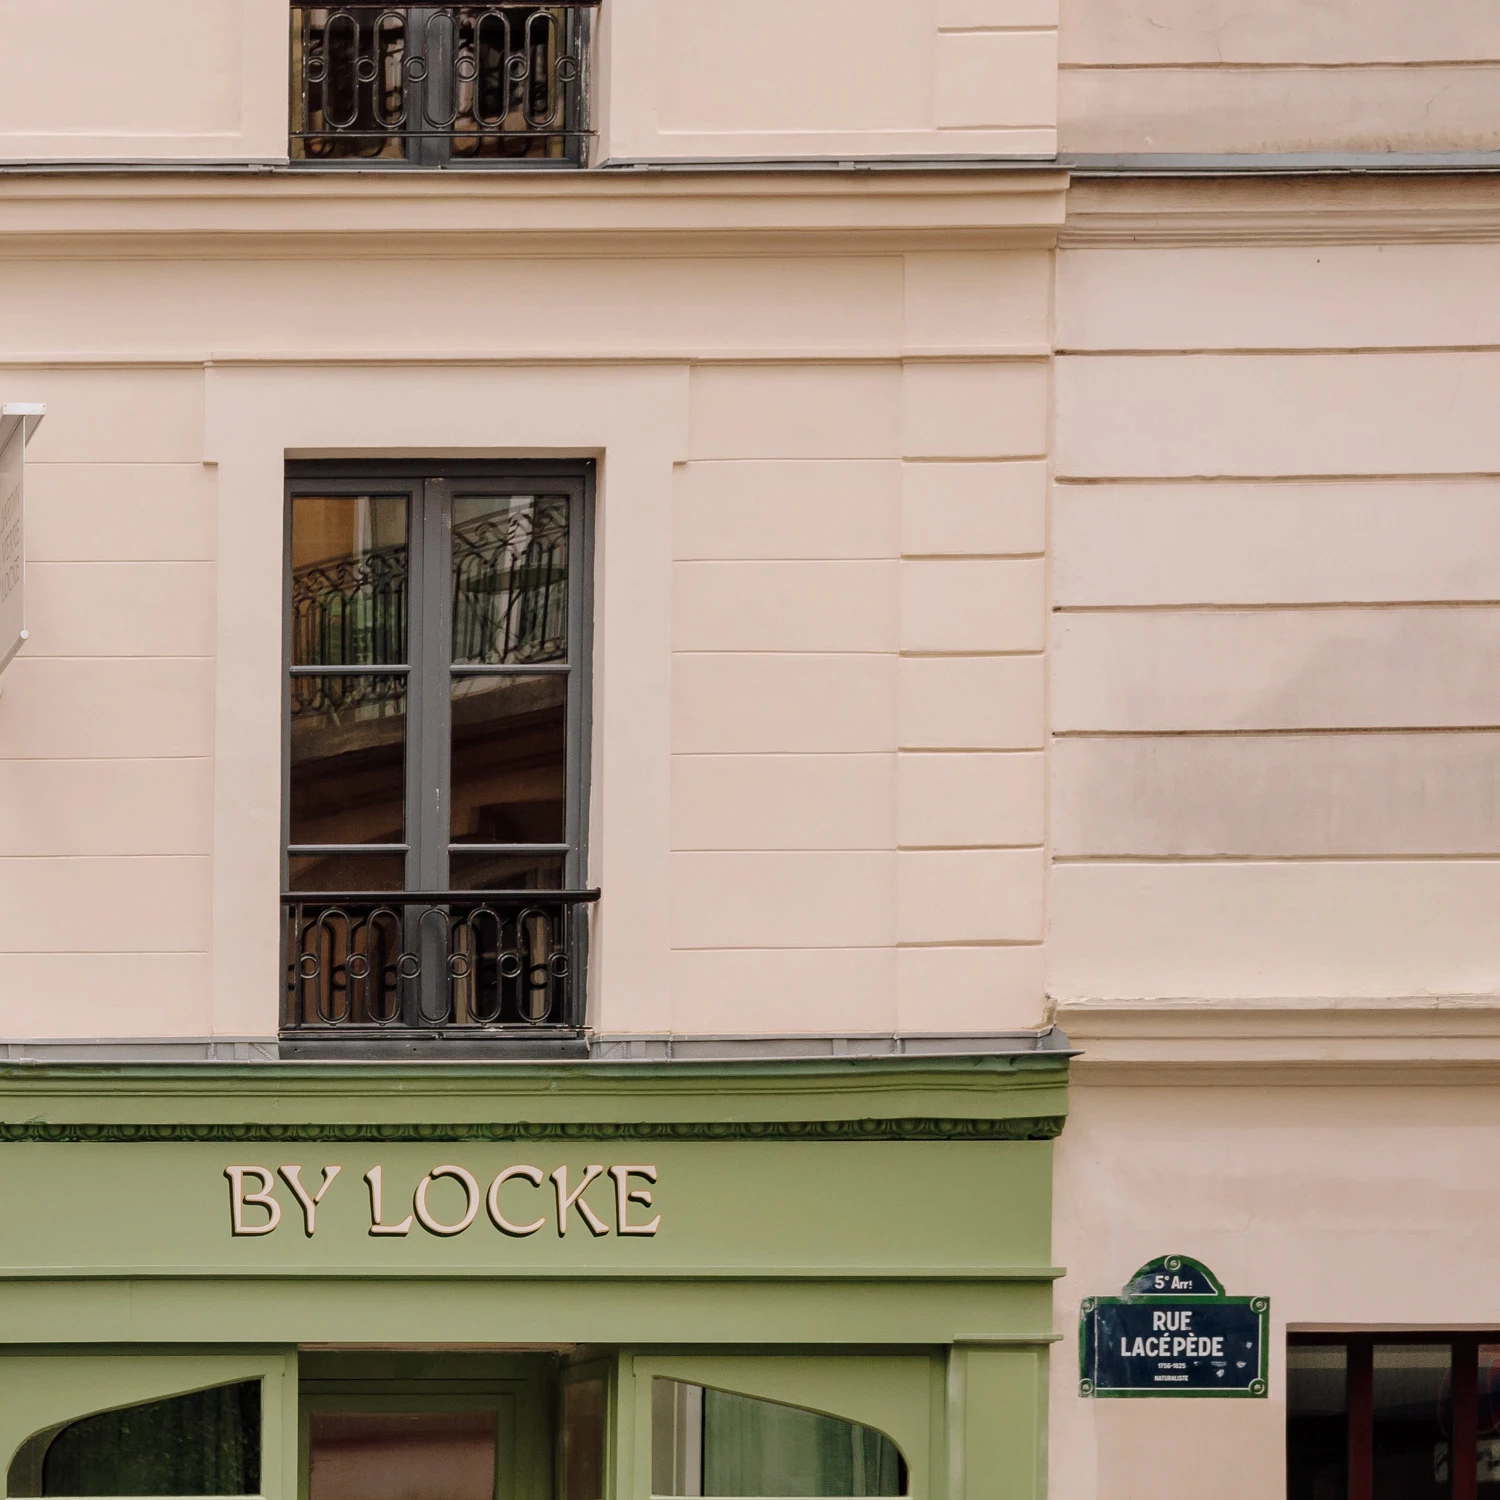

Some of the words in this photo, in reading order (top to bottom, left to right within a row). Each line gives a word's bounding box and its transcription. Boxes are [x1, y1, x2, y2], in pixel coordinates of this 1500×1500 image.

[223, 1164, 342, 1237] BY
[363, 1164, 662, 1237] LOCKE
[1152, 1310, 1193, 1331] RUE
[1120, 1332, 1224, 1357] LACÉPÈDE
